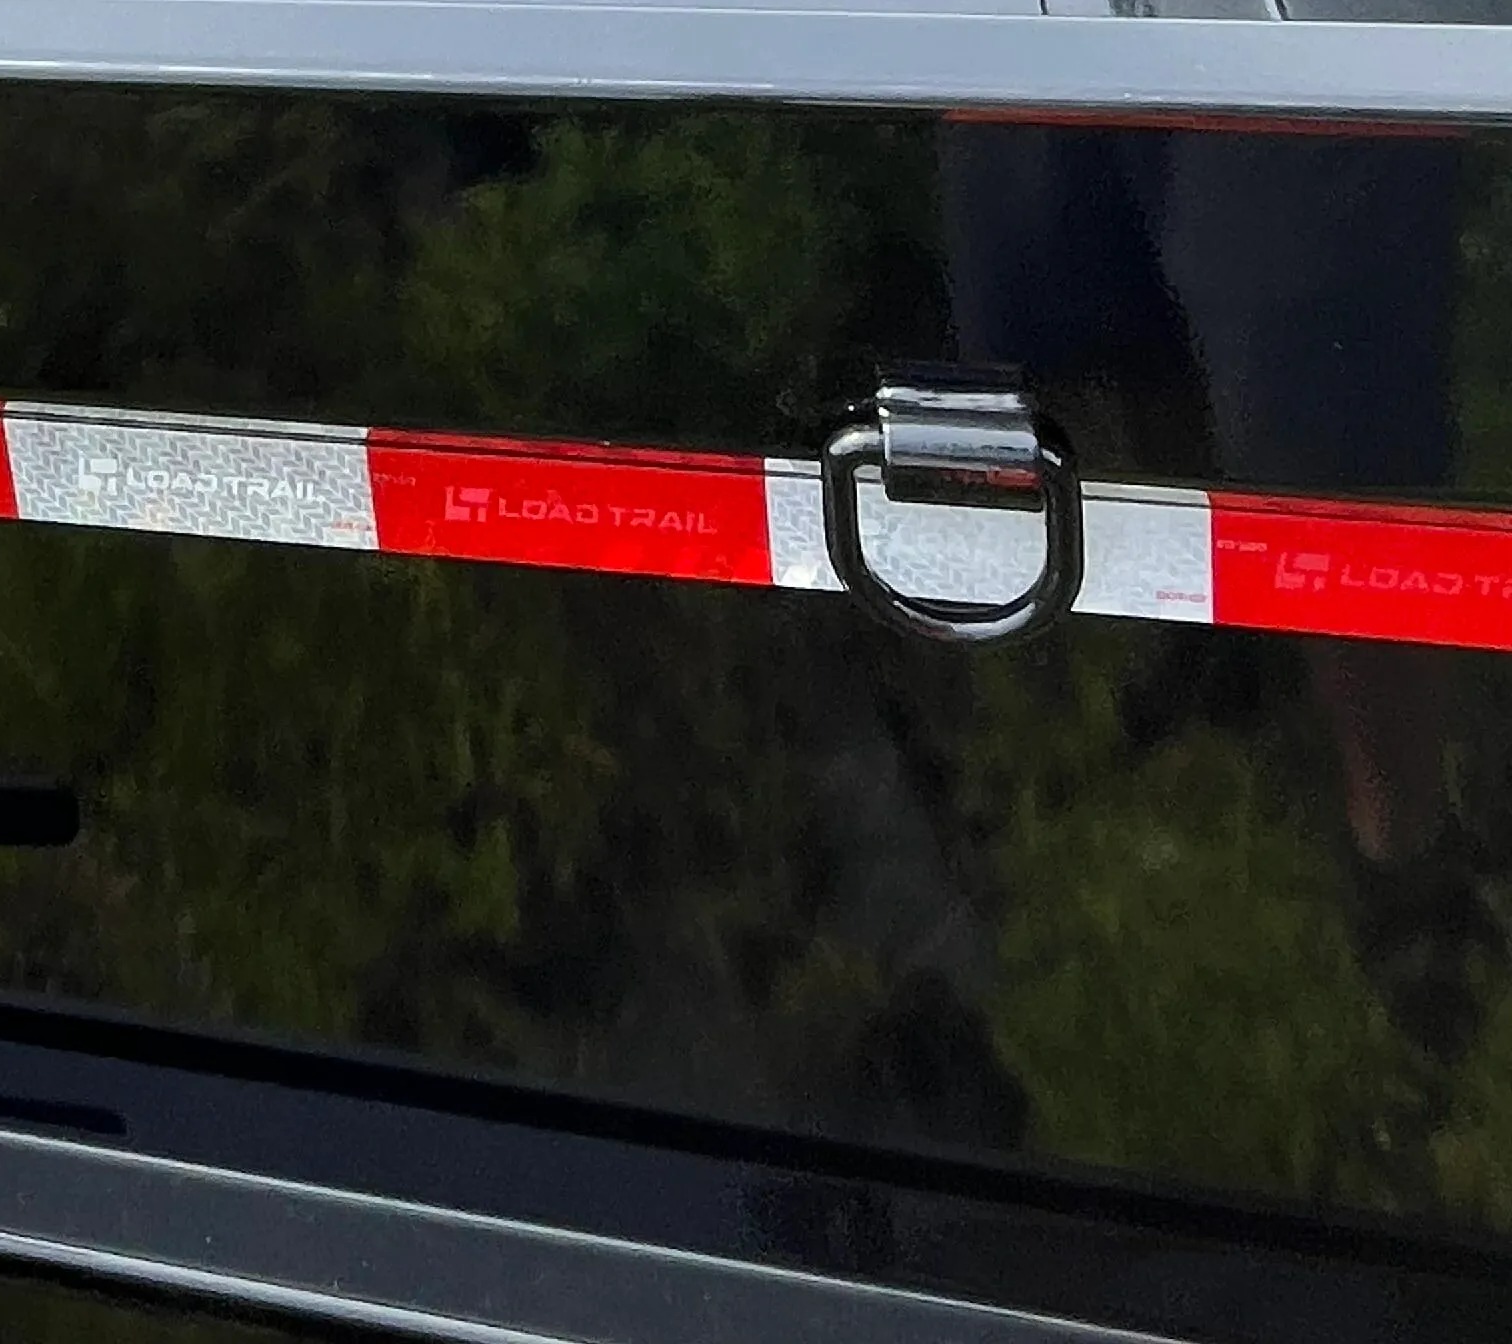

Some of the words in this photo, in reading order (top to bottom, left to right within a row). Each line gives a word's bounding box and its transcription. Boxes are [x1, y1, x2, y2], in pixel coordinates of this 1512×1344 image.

[126, 465, 218, 493] LOAD
[221, 475, 326, 502] TRAIL
[498, 496, 599, 524] LOAD
[608, 503, 718, 535] TRAIL
[1340, 563, 1464, 595] LOAD
